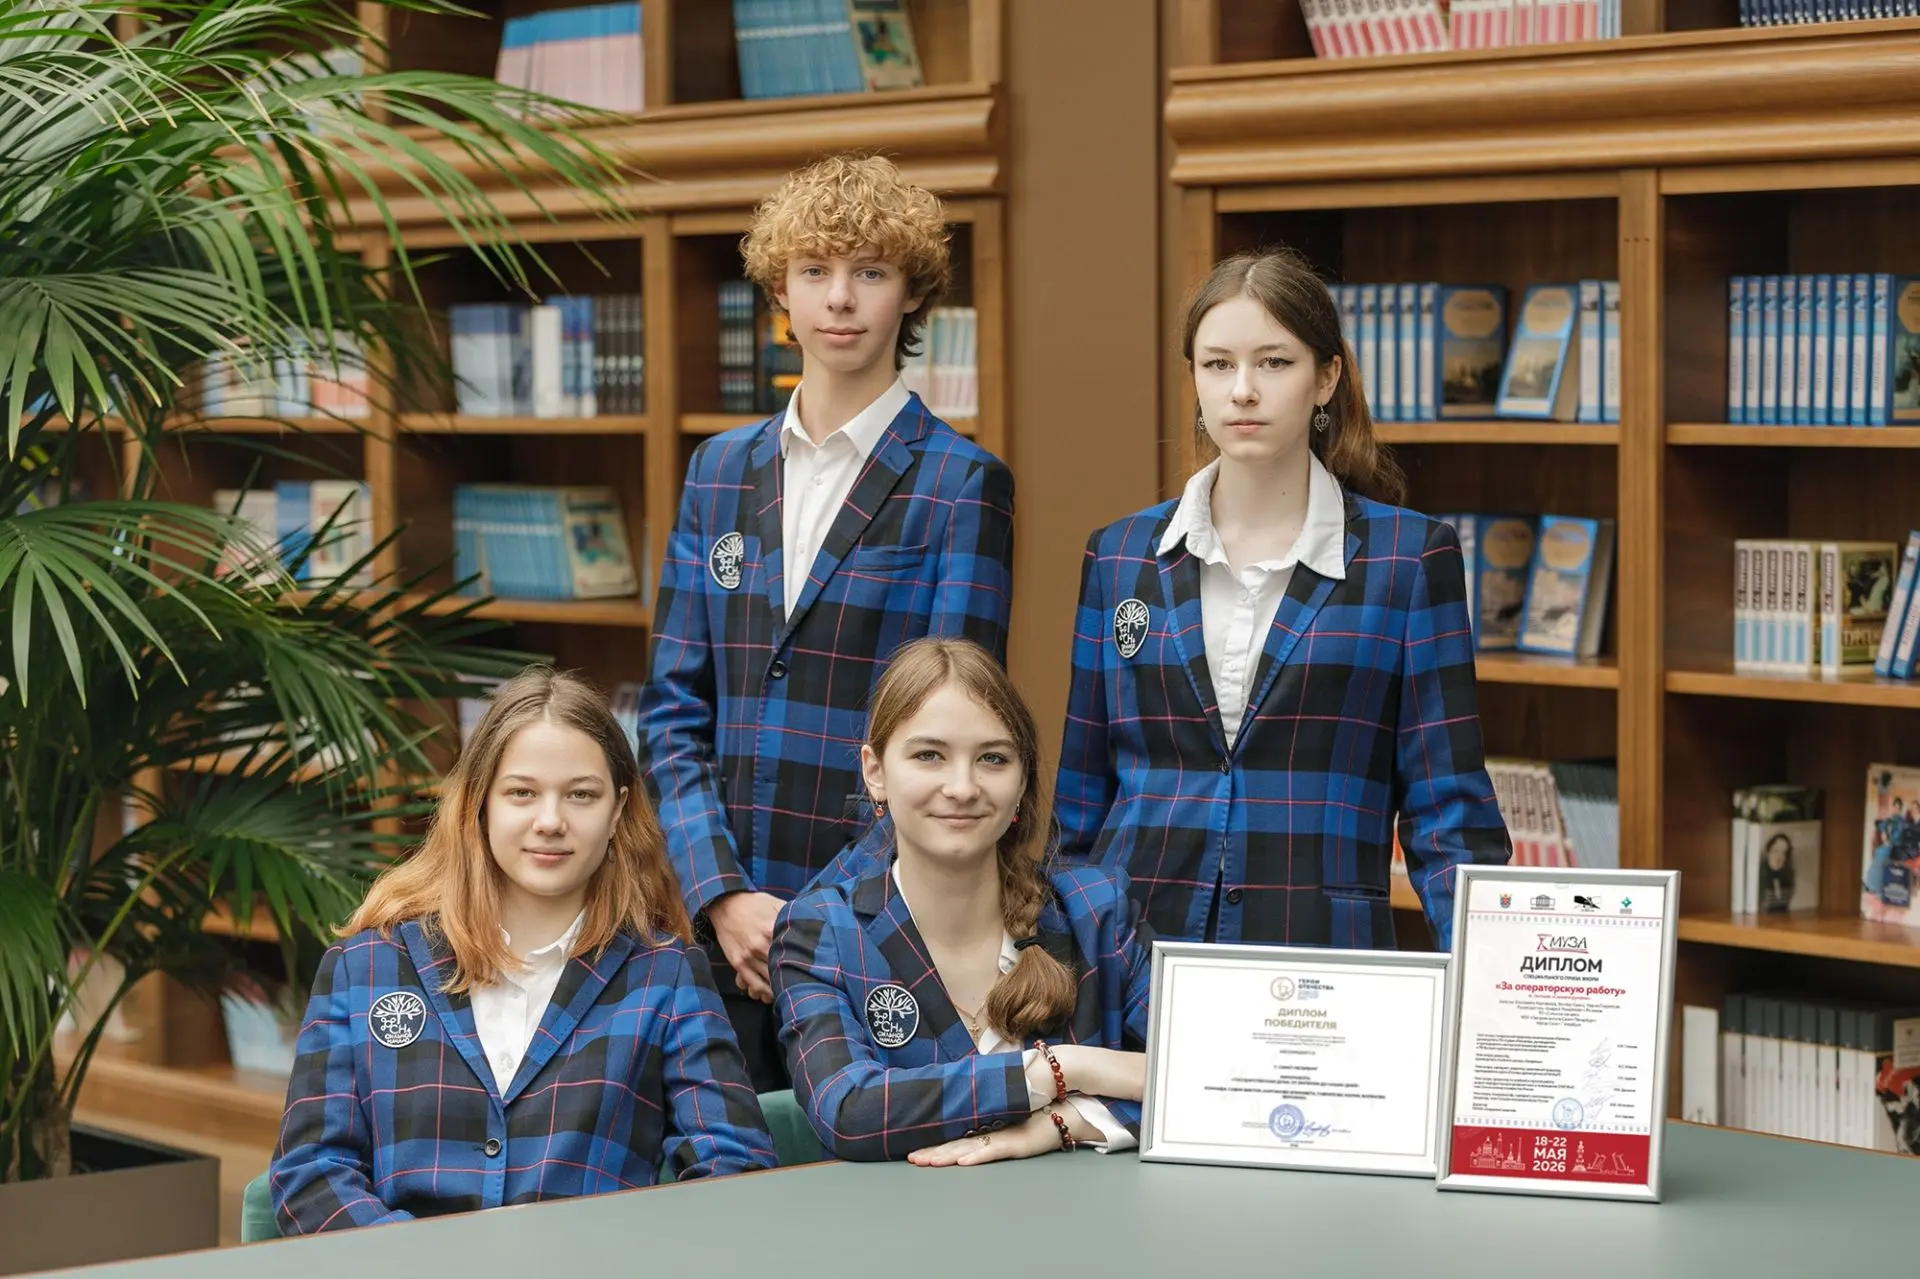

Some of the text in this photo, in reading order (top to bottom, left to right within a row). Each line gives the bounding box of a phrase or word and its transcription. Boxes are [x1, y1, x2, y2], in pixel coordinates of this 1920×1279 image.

[1520, 956, 1602, 973] ДИПЛОМ
[1495, 981, 1626, 997] «За операторскую работу»
[1278, 1007, 1327, 1018] ДИПЛОМ
[1264, 1018, 1337, 1030] ПОБЕДИТЕЛЯ
[1535, 1136, 1567, 1147] 18-22
[1534, 1147, 1567, 1160] МАЯ
[1532, 1160, 1566, 1172] 2026
